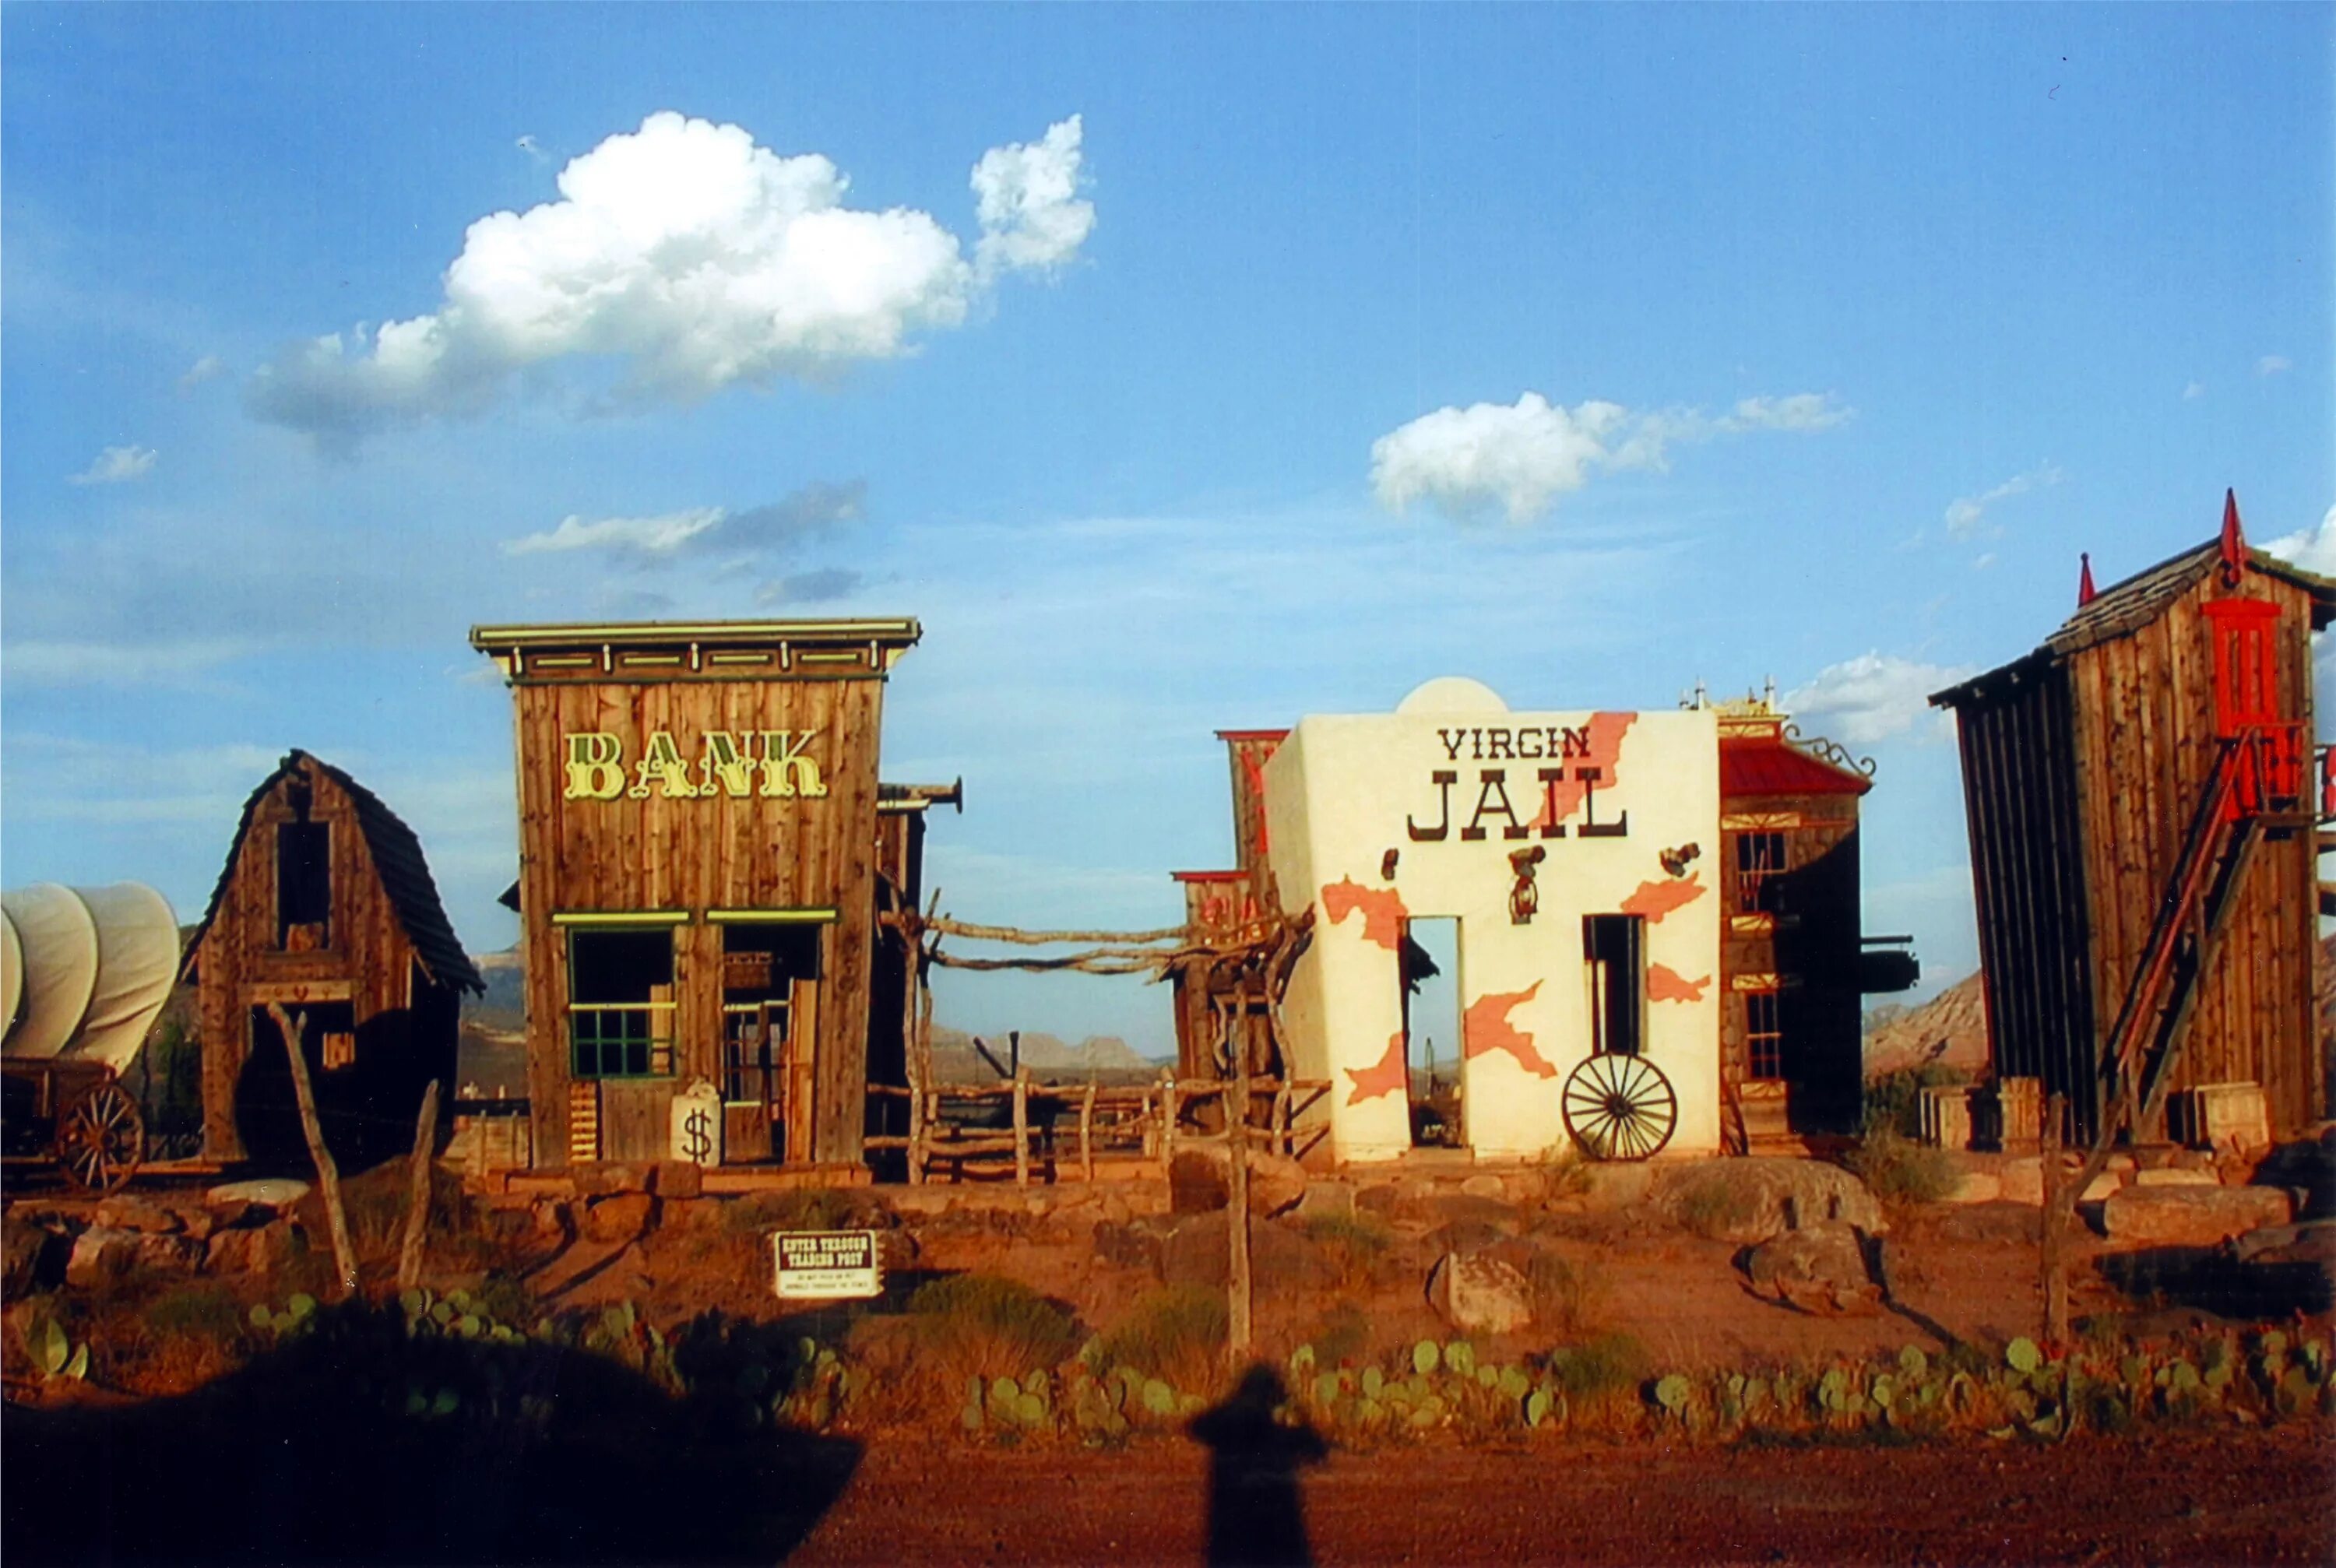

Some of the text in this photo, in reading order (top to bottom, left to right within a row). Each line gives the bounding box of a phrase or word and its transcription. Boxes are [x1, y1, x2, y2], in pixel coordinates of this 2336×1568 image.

[1437, 727, 1591, 761] VIRGIN
[564, 730, 828, 800] BANK
[1407, 767, 1627, 842] JAIL
[783, 1236, 867, 1253] ENTER THROUGH
[788, 1252, 863, 1267] TRADING POST
